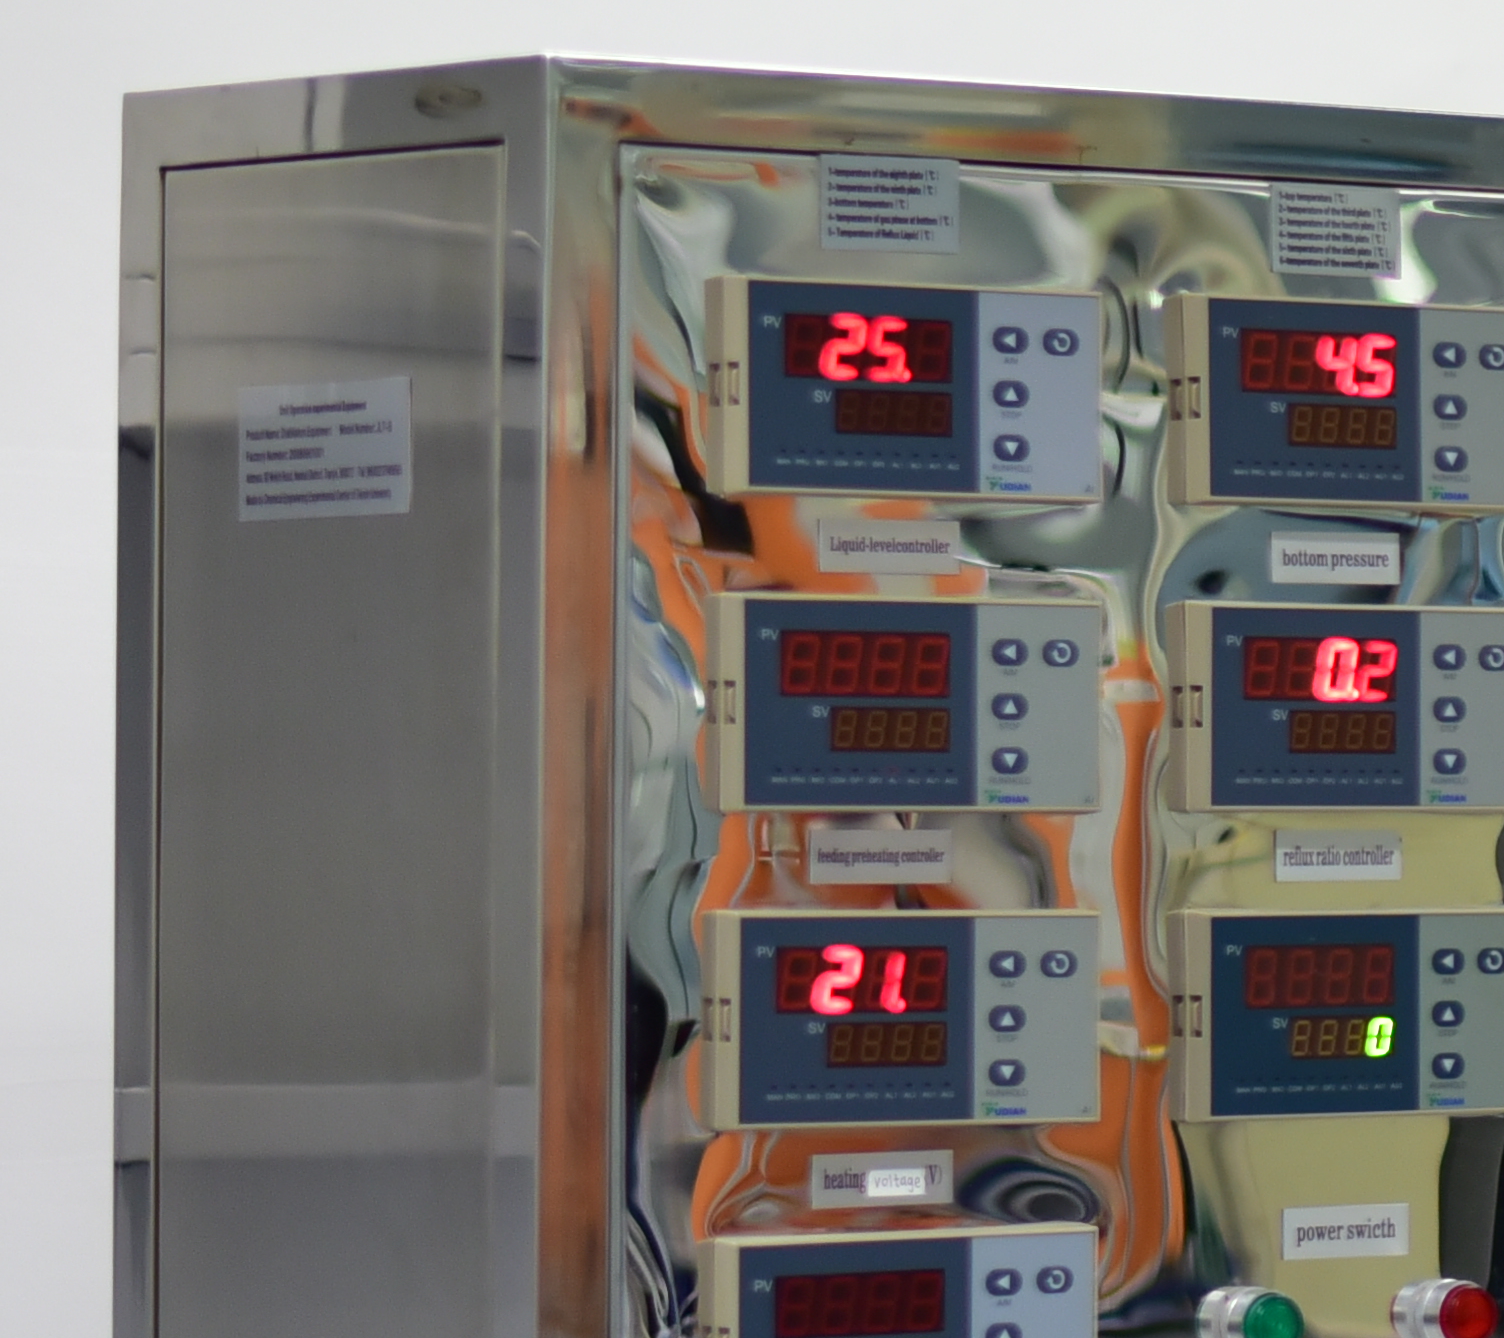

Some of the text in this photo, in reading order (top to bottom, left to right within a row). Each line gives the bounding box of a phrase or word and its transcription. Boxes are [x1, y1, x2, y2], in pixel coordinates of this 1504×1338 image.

[763, 316, 782, 328] PV
[1222, 327, 1239, 339] PV
[813, 390, 832, 403] SV
[1270, 402, 1287, 413] SV
[1282, 548, 1390, 571] bottom pressure
[761, 628, 779, 640] PV
[1226, 635, 1243, 647] PV
[812, 706, 831, 718] SV
[1272, 709, 1288, 721] SV
[901, 848, 945, 863] controller
[1283, 845, 1394, 866] reflux ratio controller
[757, 946, 775, 958] PV
[1226, 945, 1242, 956] PV
[808, 1022, 826, 1034] SV
[1272, 1018, 1288, 1029] SV
[824, 1167, 866, 1193] heating
[874, 1174, 920, 1192] voltage
[1296, 1222, 1344, 1247] power
[753, 1280, 772, 1292] PV
